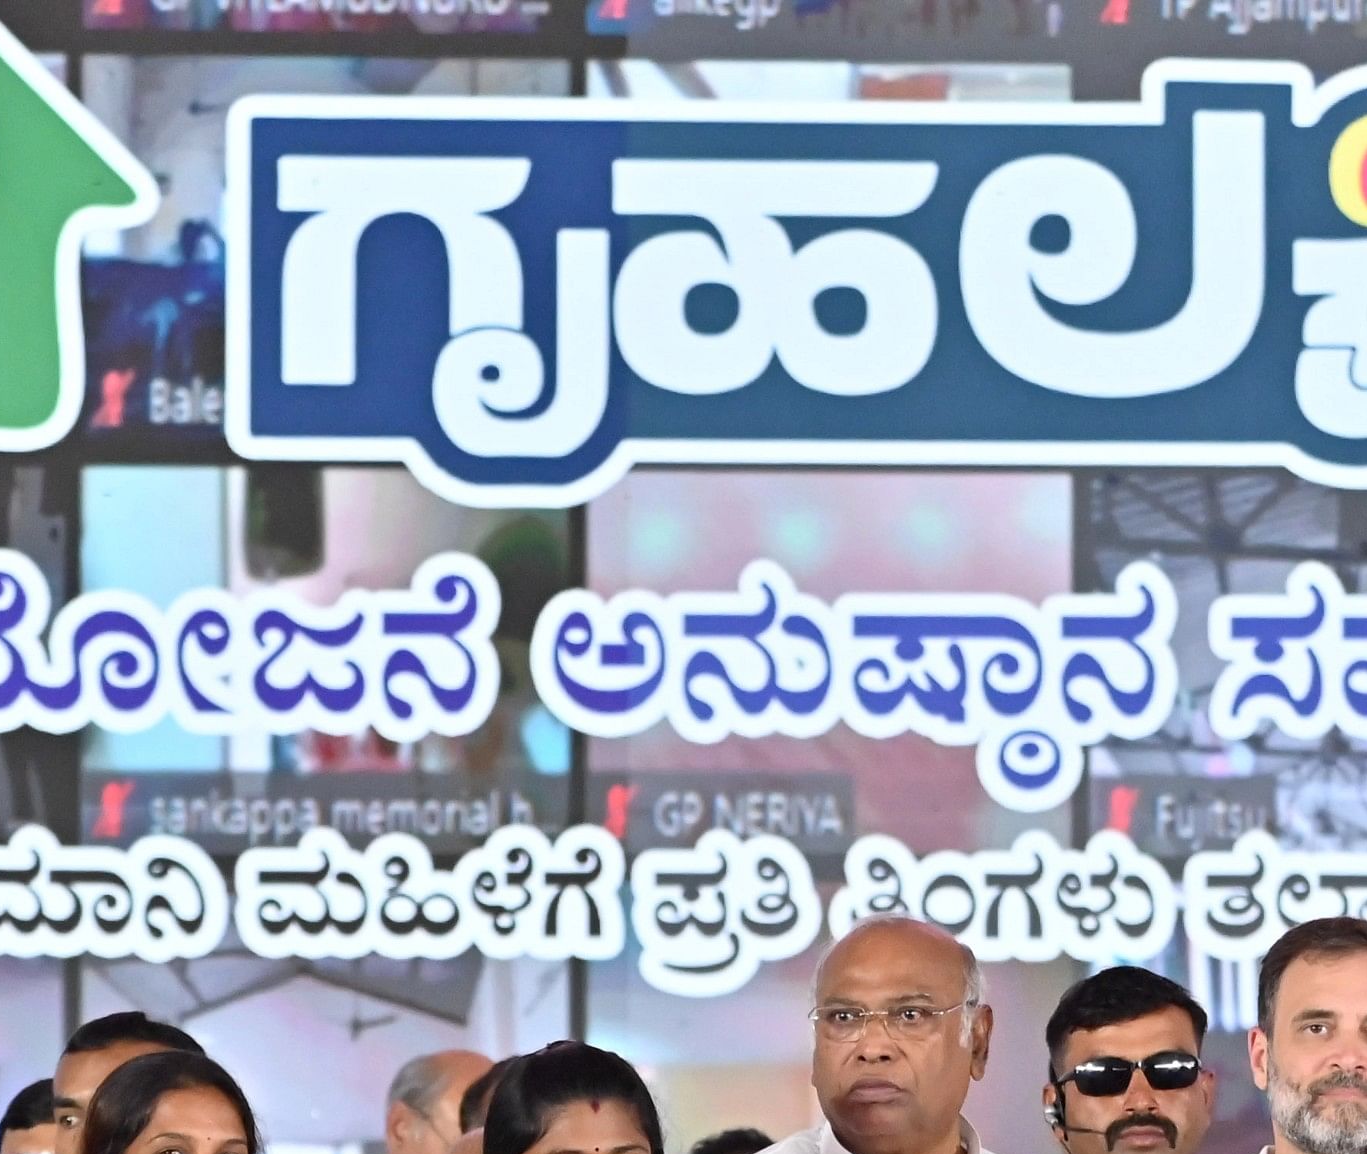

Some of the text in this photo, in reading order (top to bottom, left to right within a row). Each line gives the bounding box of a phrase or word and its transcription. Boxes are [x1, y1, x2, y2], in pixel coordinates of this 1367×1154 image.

[148, 379, 225, 424] Bale
[257, 846, 603, 938] ಮಹಿಳೆಗೆ
[654, 849, 803, 974] ಪ್ರತಿ
